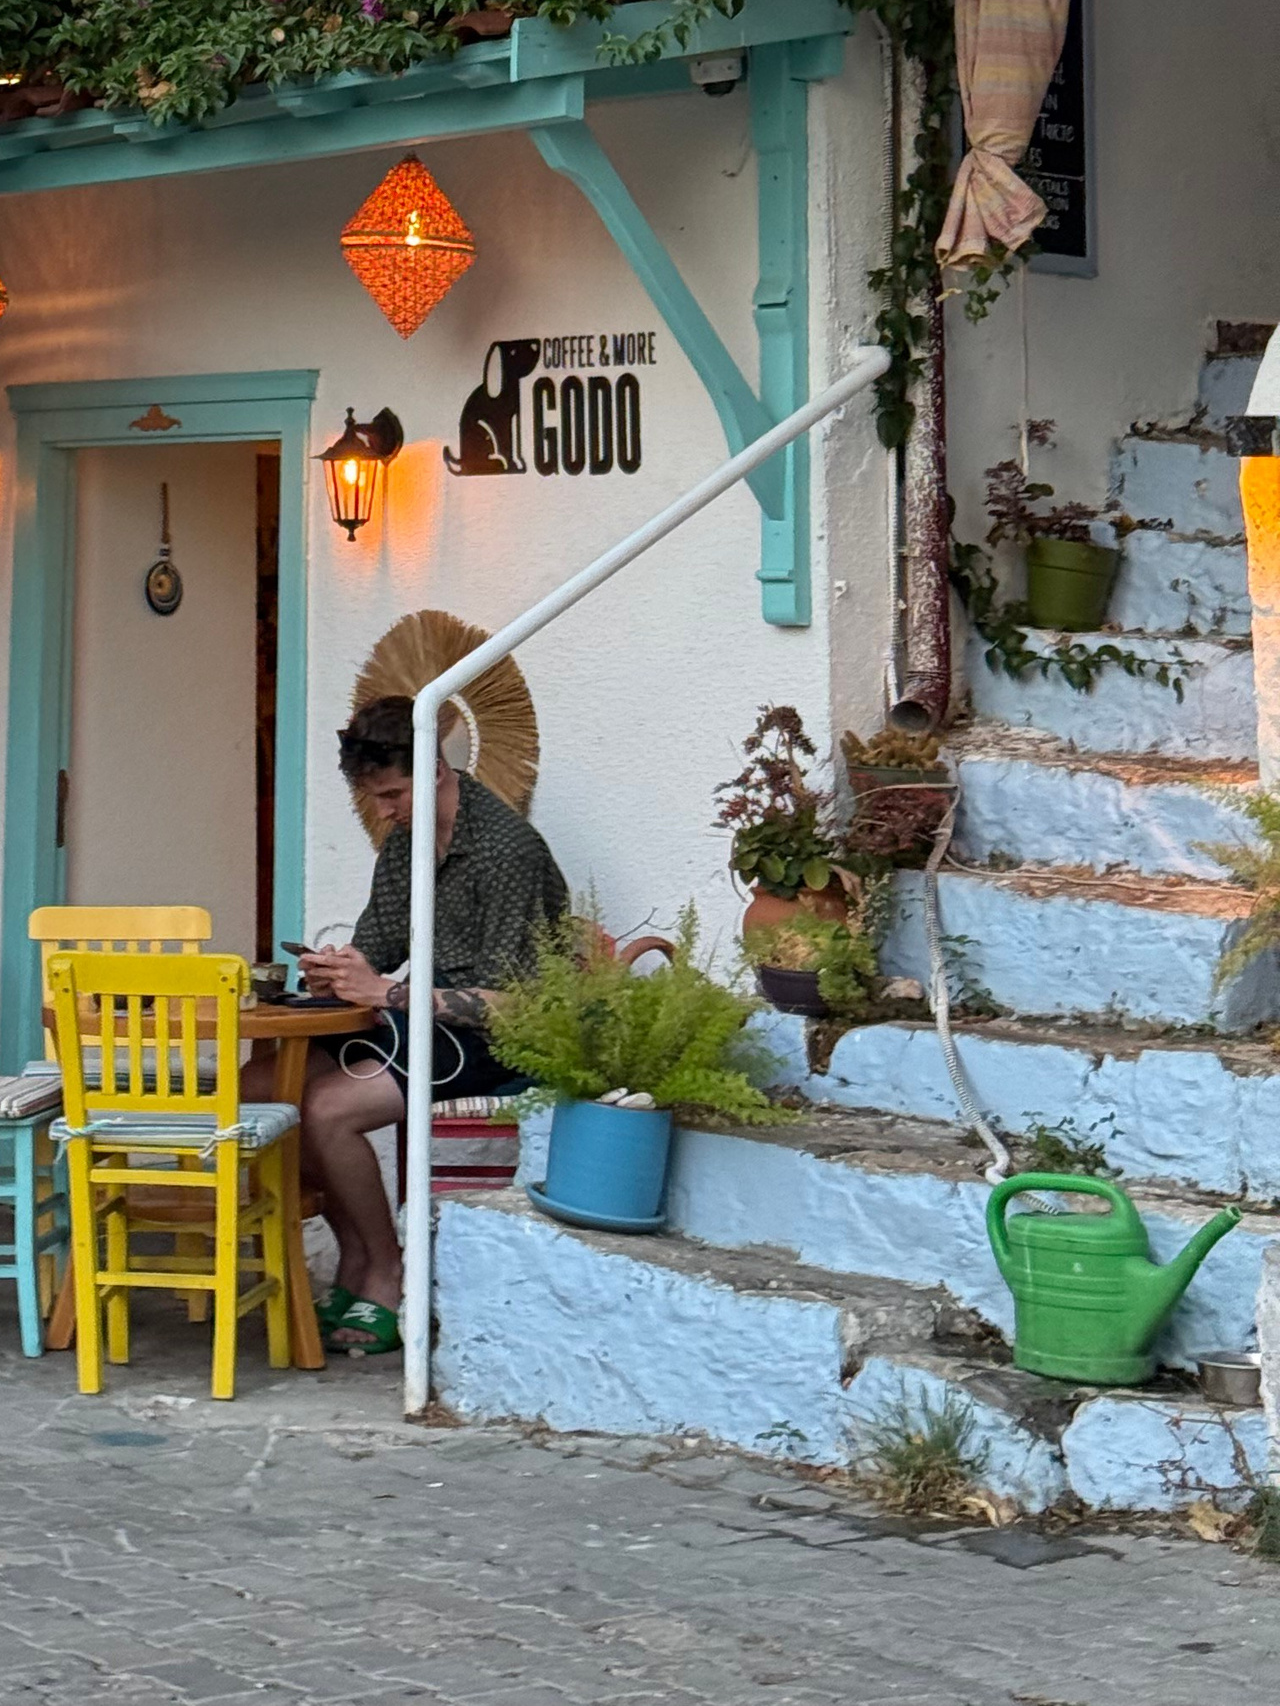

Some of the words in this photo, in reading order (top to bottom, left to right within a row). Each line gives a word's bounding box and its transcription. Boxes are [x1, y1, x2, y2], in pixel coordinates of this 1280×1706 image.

[543, 335, 595, 369] COFFEE
[598, 334, 611, 367] &
[613, 332, 656, 366] MORE
[533, 373, 641, 476] GODO
